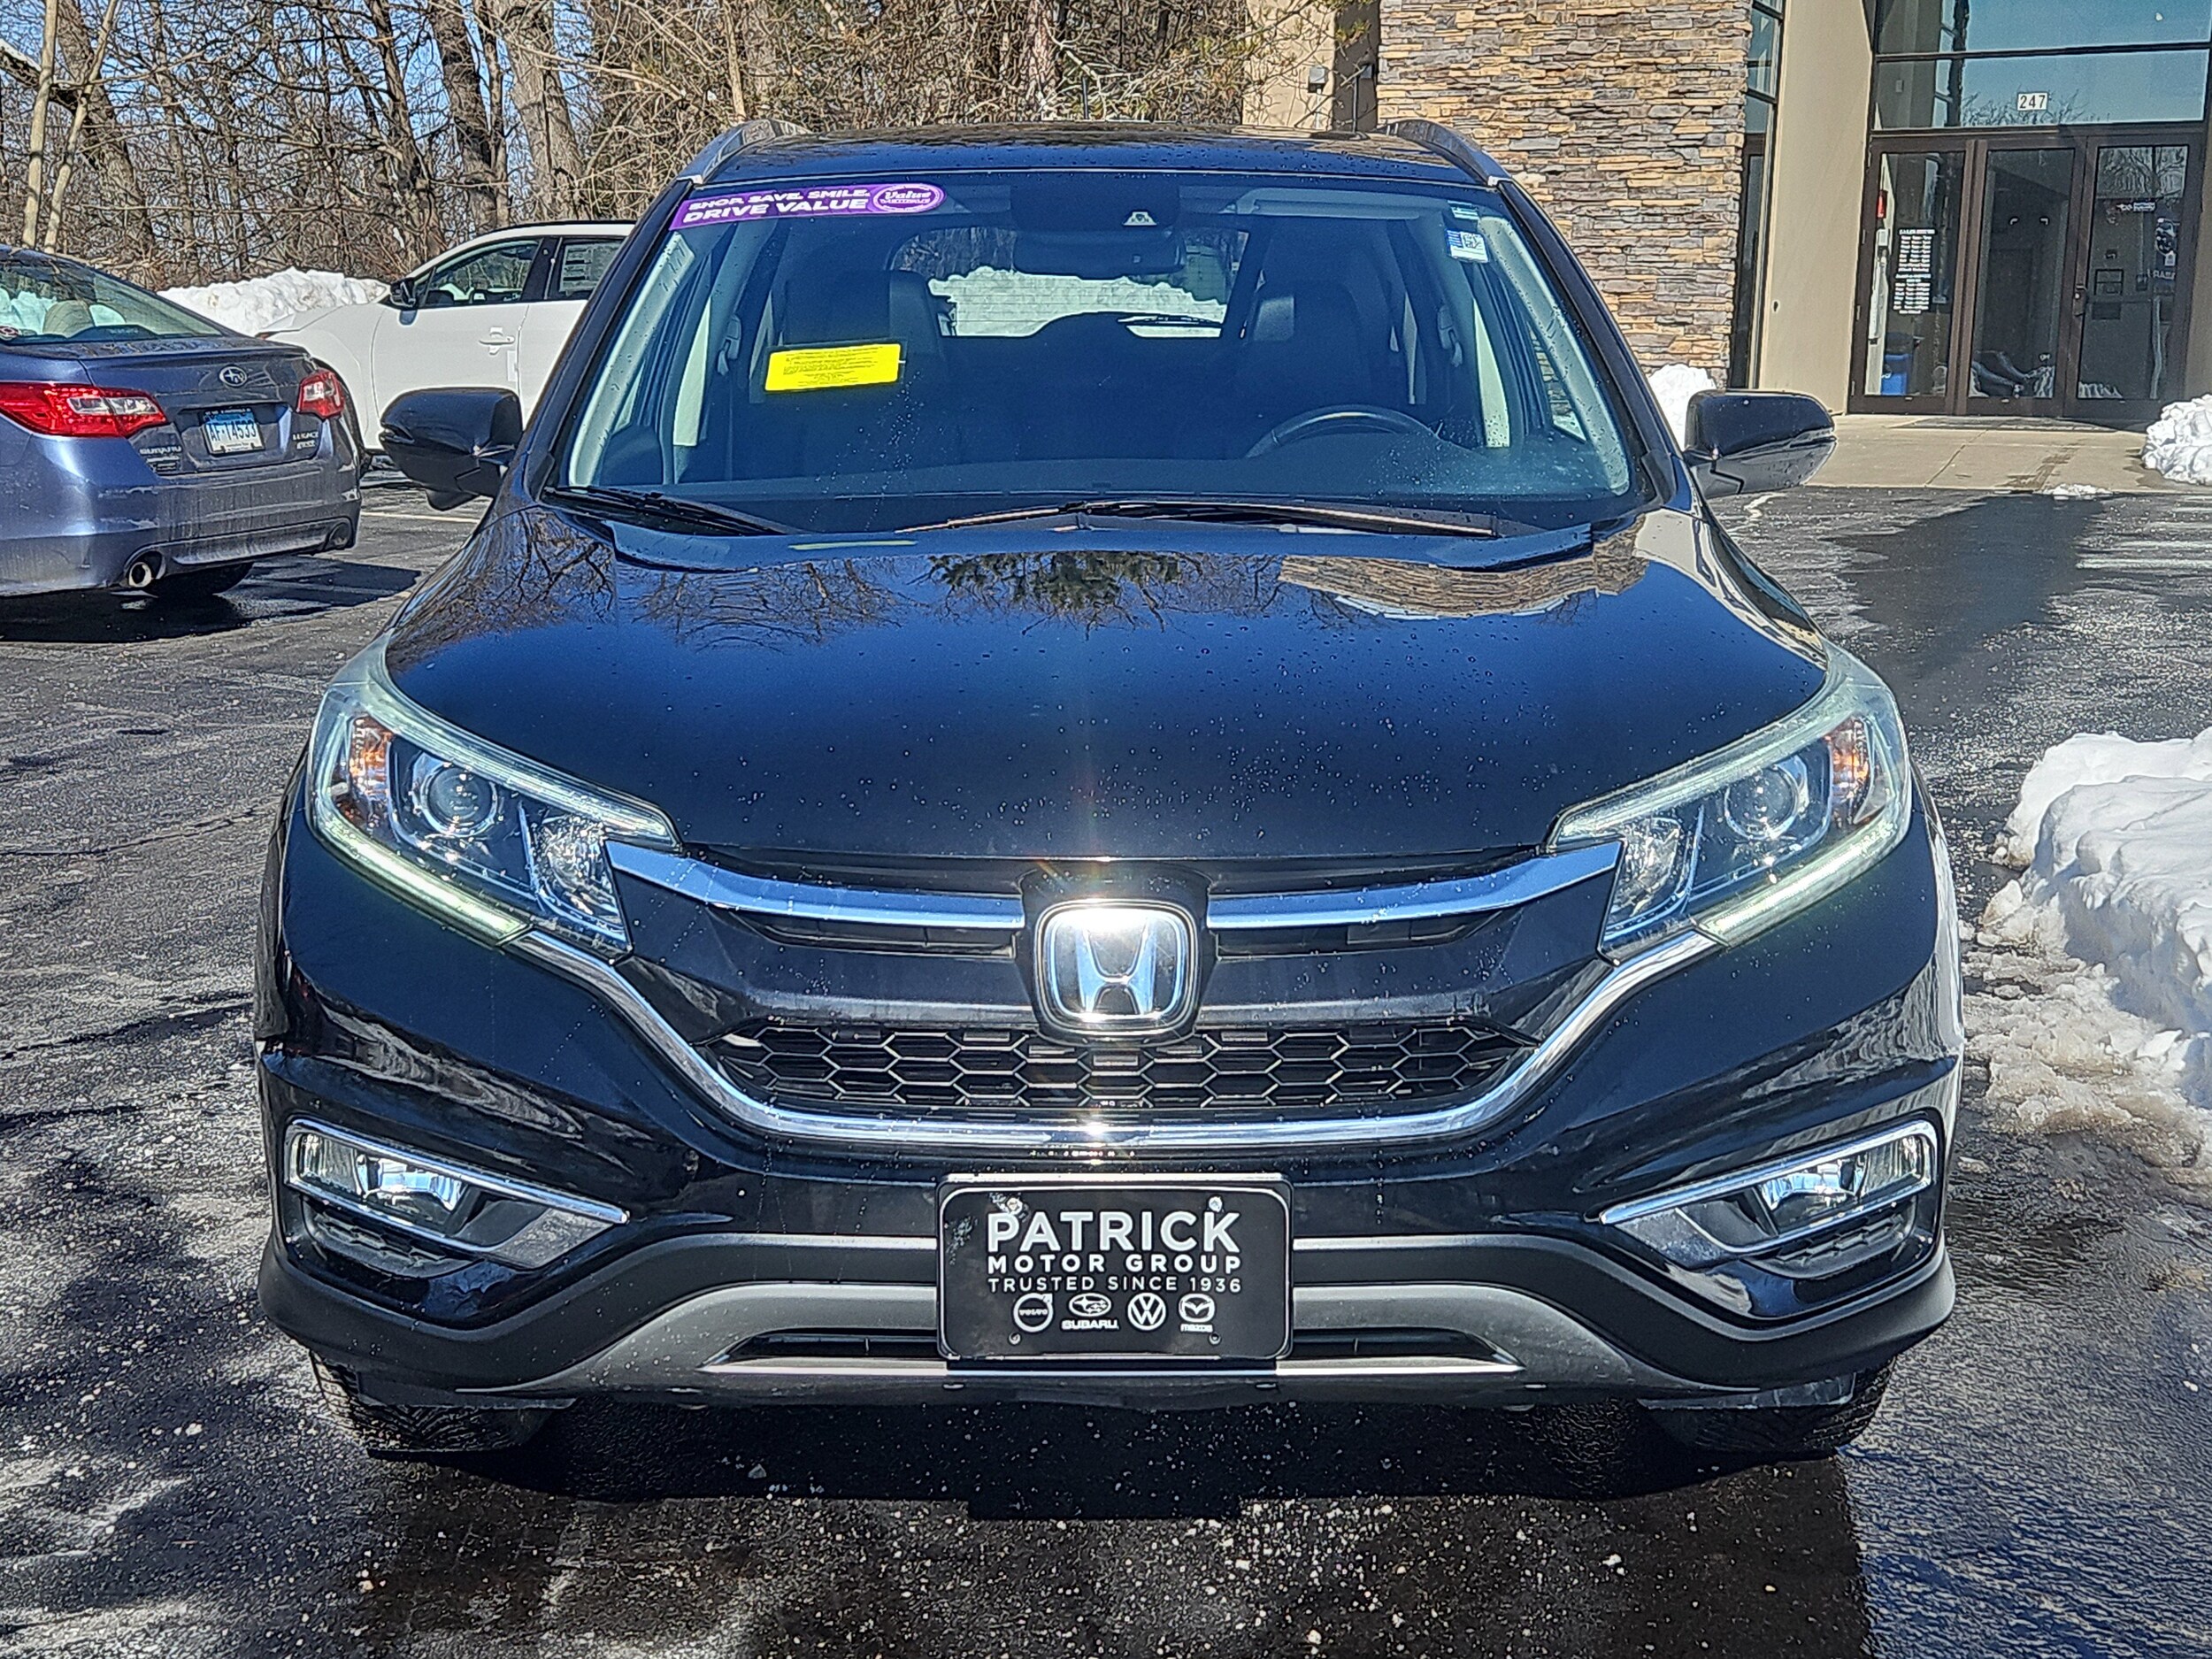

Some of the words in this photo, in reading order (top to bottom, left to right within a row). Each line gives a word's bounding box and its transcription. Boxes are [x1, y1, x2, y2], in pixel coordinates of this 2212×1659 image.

[2019, 95, 2046, 109] 247
[885, 190, 932, 200] Value
[683, 204, 770, 223] DRIVE
[776, 199, 869, 213] VALUE
[987, 1210, 1240, 1253] PATRICK
[987, 1254, 1105, 1274] MOTOR
[1125, 1254, 1240, 1274] GROUP
[987, 1277, 1094, 1293] TRUSTED
[1108, 1277, 1178, 1291] SINCE
[1189, 1277, 1241, 1293] 1936
[1062, 1319, 1118, 1331] SUBARU
